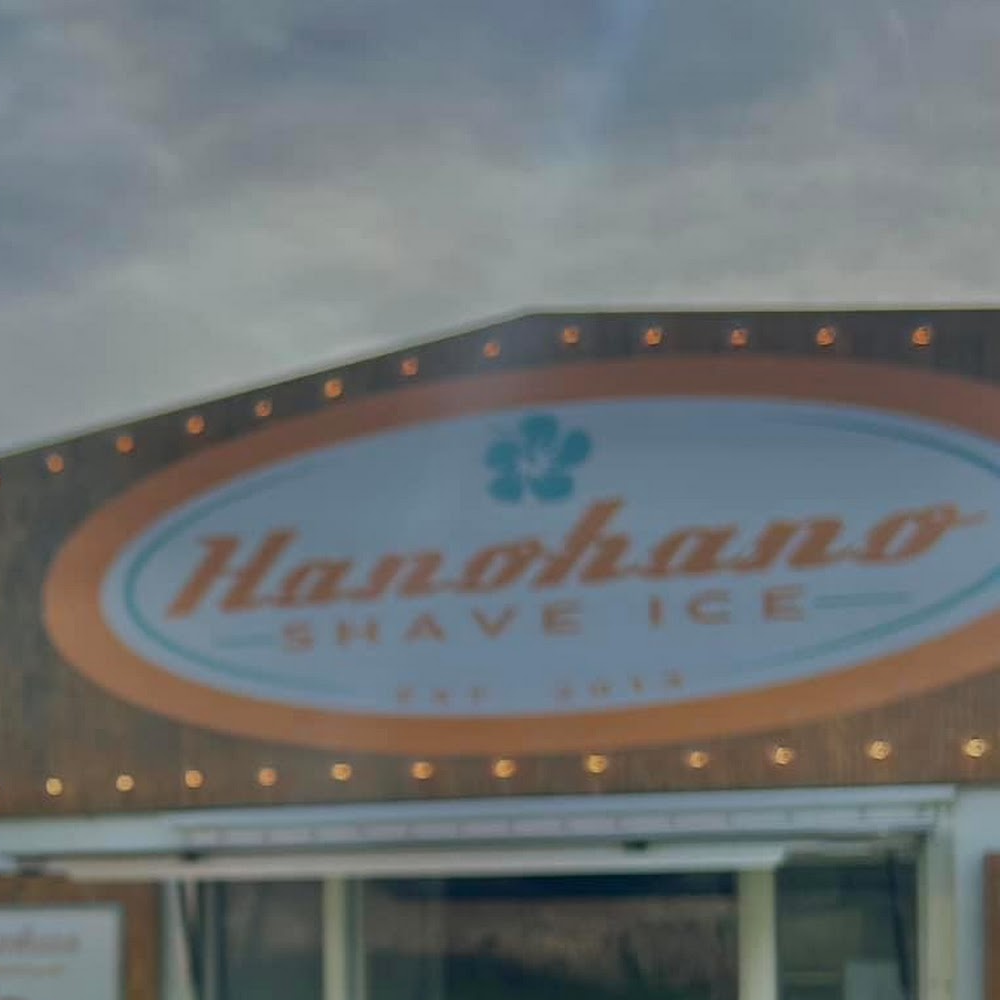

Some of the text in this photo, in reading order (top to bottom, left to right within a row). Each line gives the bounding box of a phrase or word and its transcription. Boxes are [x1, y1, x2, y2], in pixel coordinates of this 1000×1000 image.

[165, 496, 987, 620] Hanohano
[283, 584, 806, 651] SHAVE ICE
